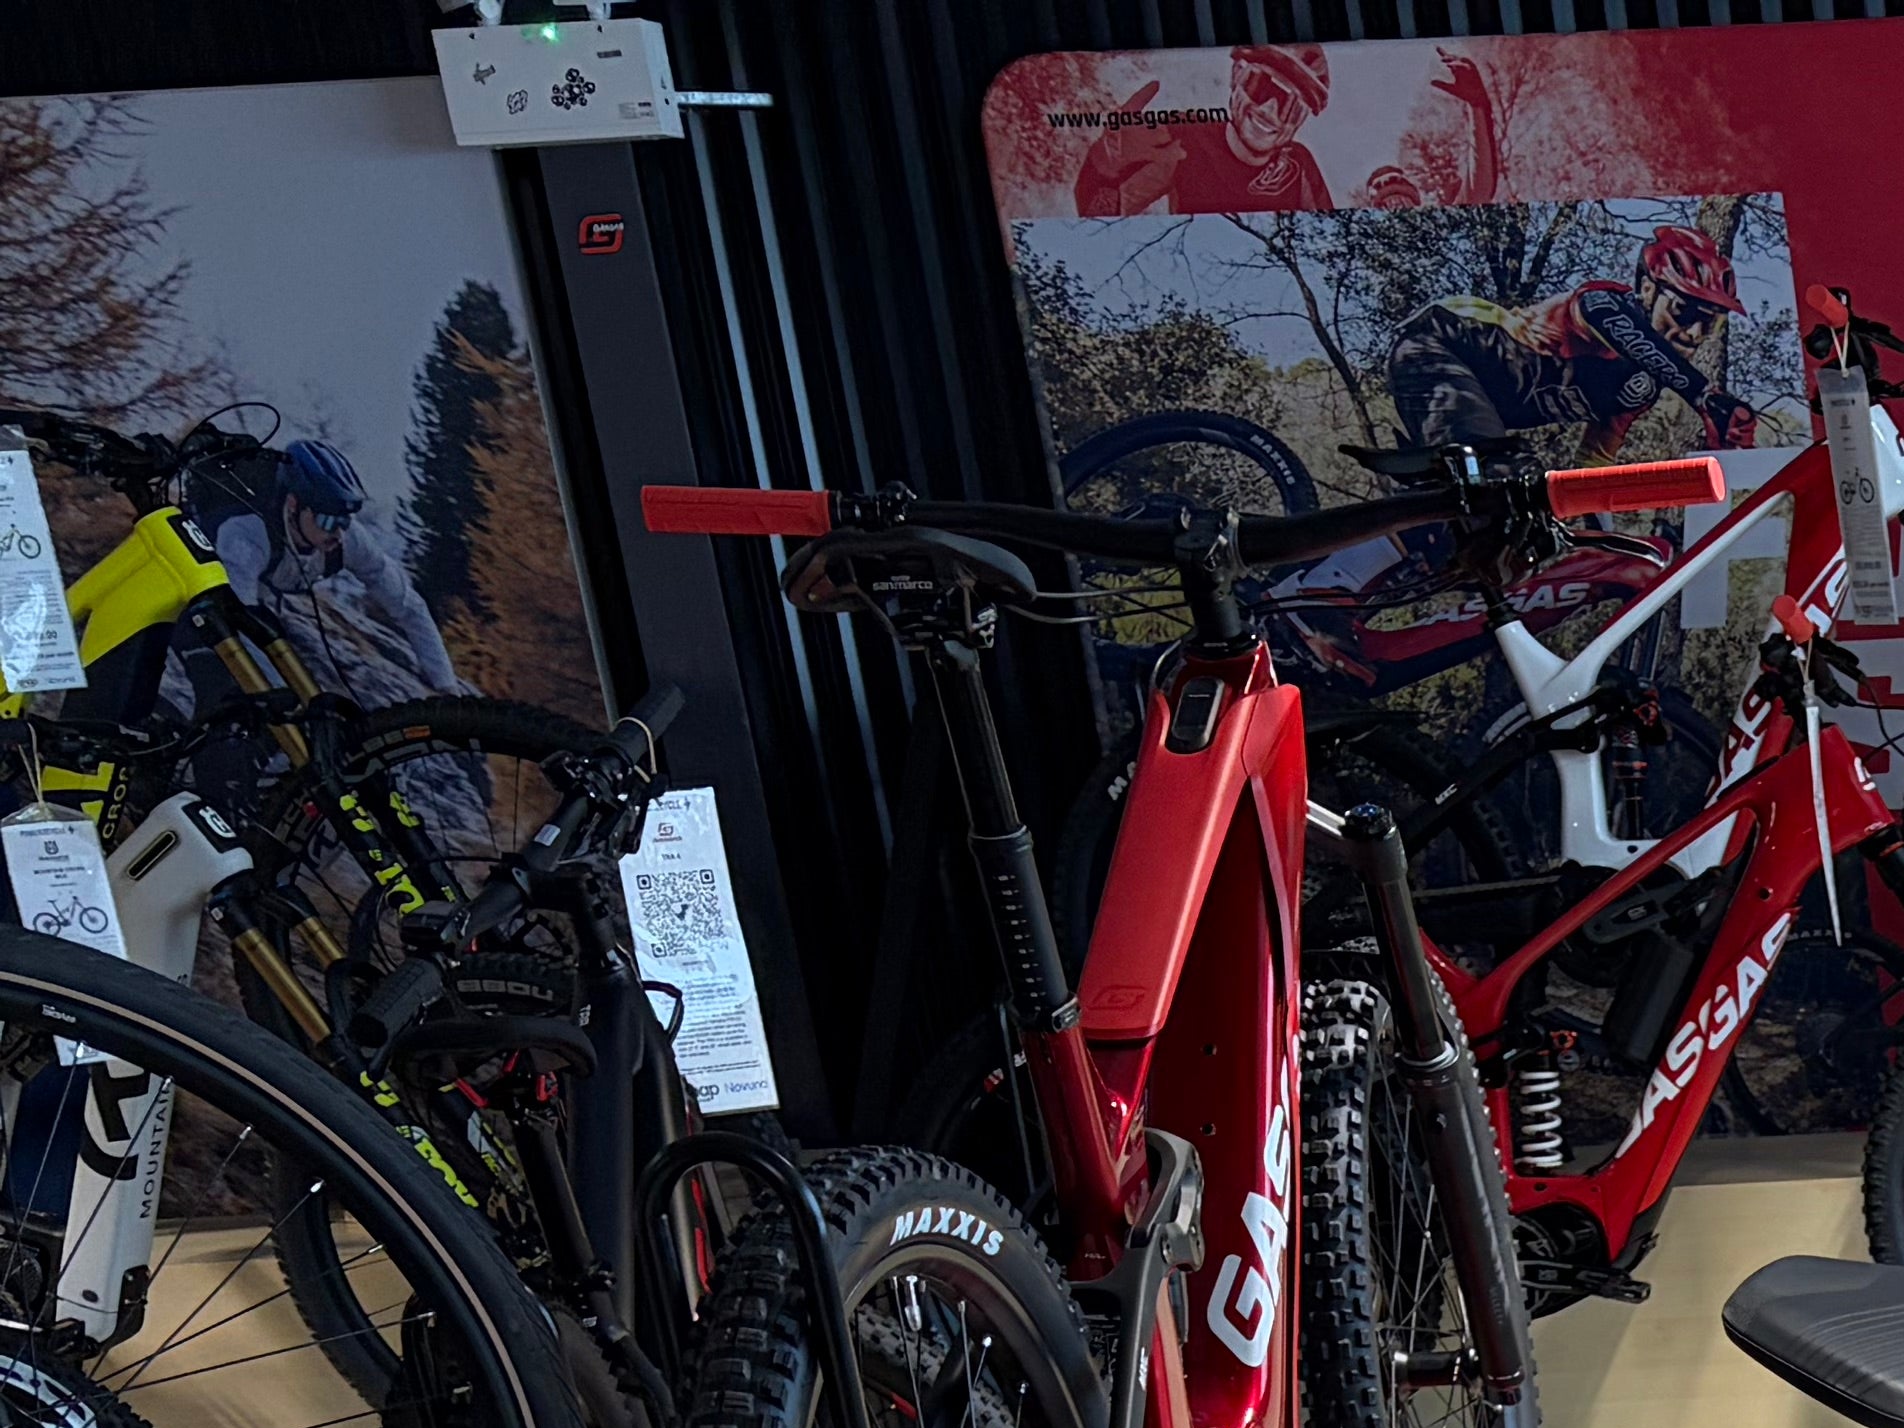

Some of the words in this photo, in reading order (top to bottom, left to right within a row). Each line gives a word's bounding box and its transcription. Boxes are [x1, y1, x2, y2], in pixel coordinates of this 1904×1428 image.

[1048, 105, 1229, 131] www.gasgas.com
[1250, 434, 1297, 486] MAXXIS
[894, 1204, 1005, 1260] MAXXIS
